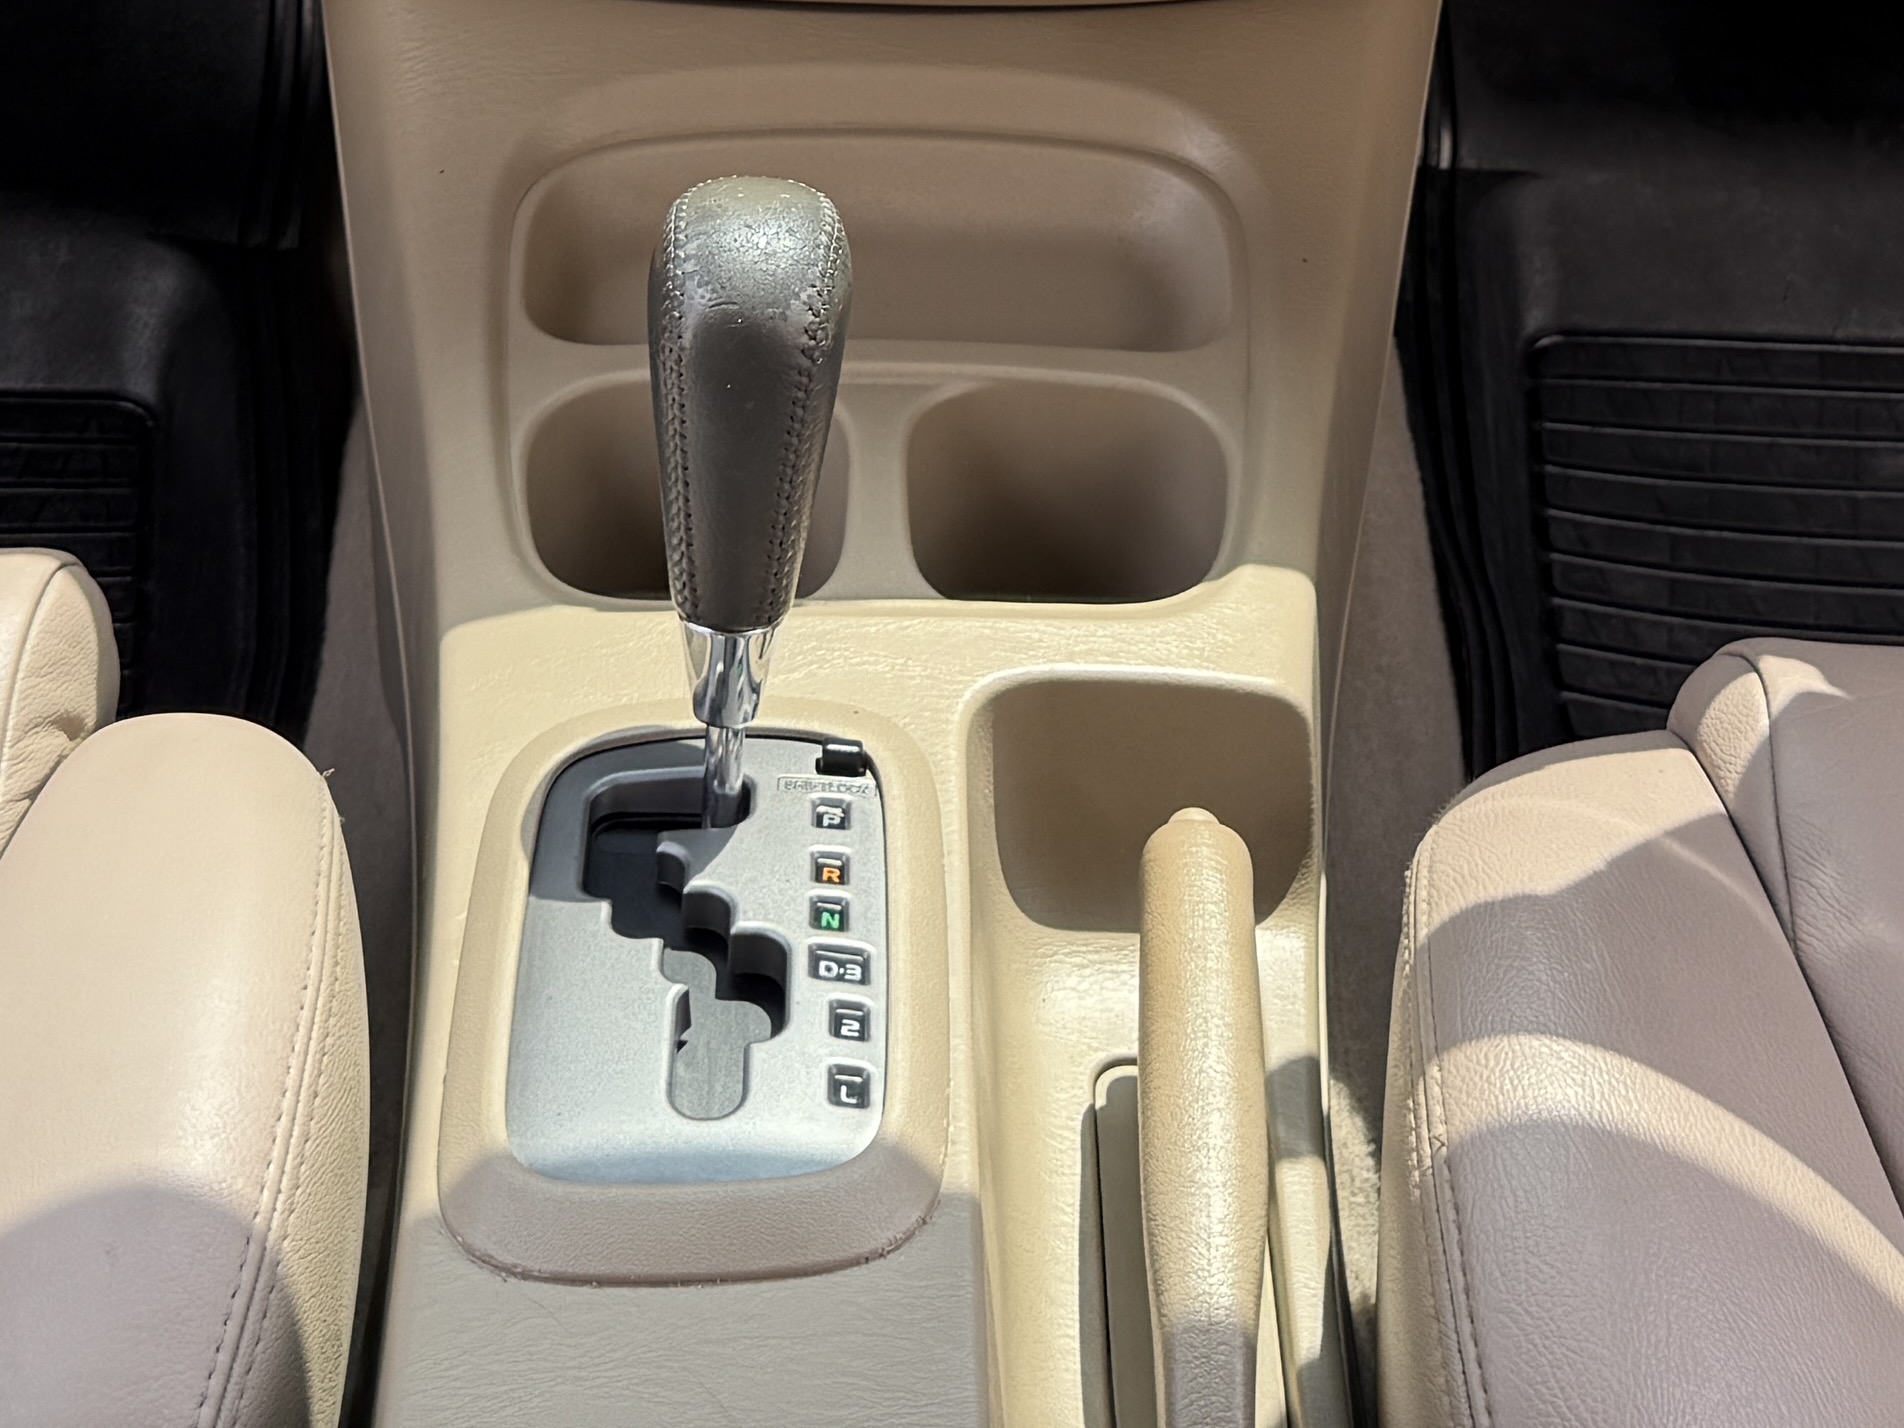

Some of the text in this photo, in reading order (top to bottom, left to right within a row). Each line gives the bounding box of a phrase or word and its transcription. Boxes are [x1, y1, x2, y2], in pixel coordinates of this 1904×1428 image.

[823, 813, 841, 827] P
[822, 867, 841, 883] R
[821, 911, 840, 929] N
[840, 1019, 860, 1037] 2
[839, 1085, 858, 1104] L
